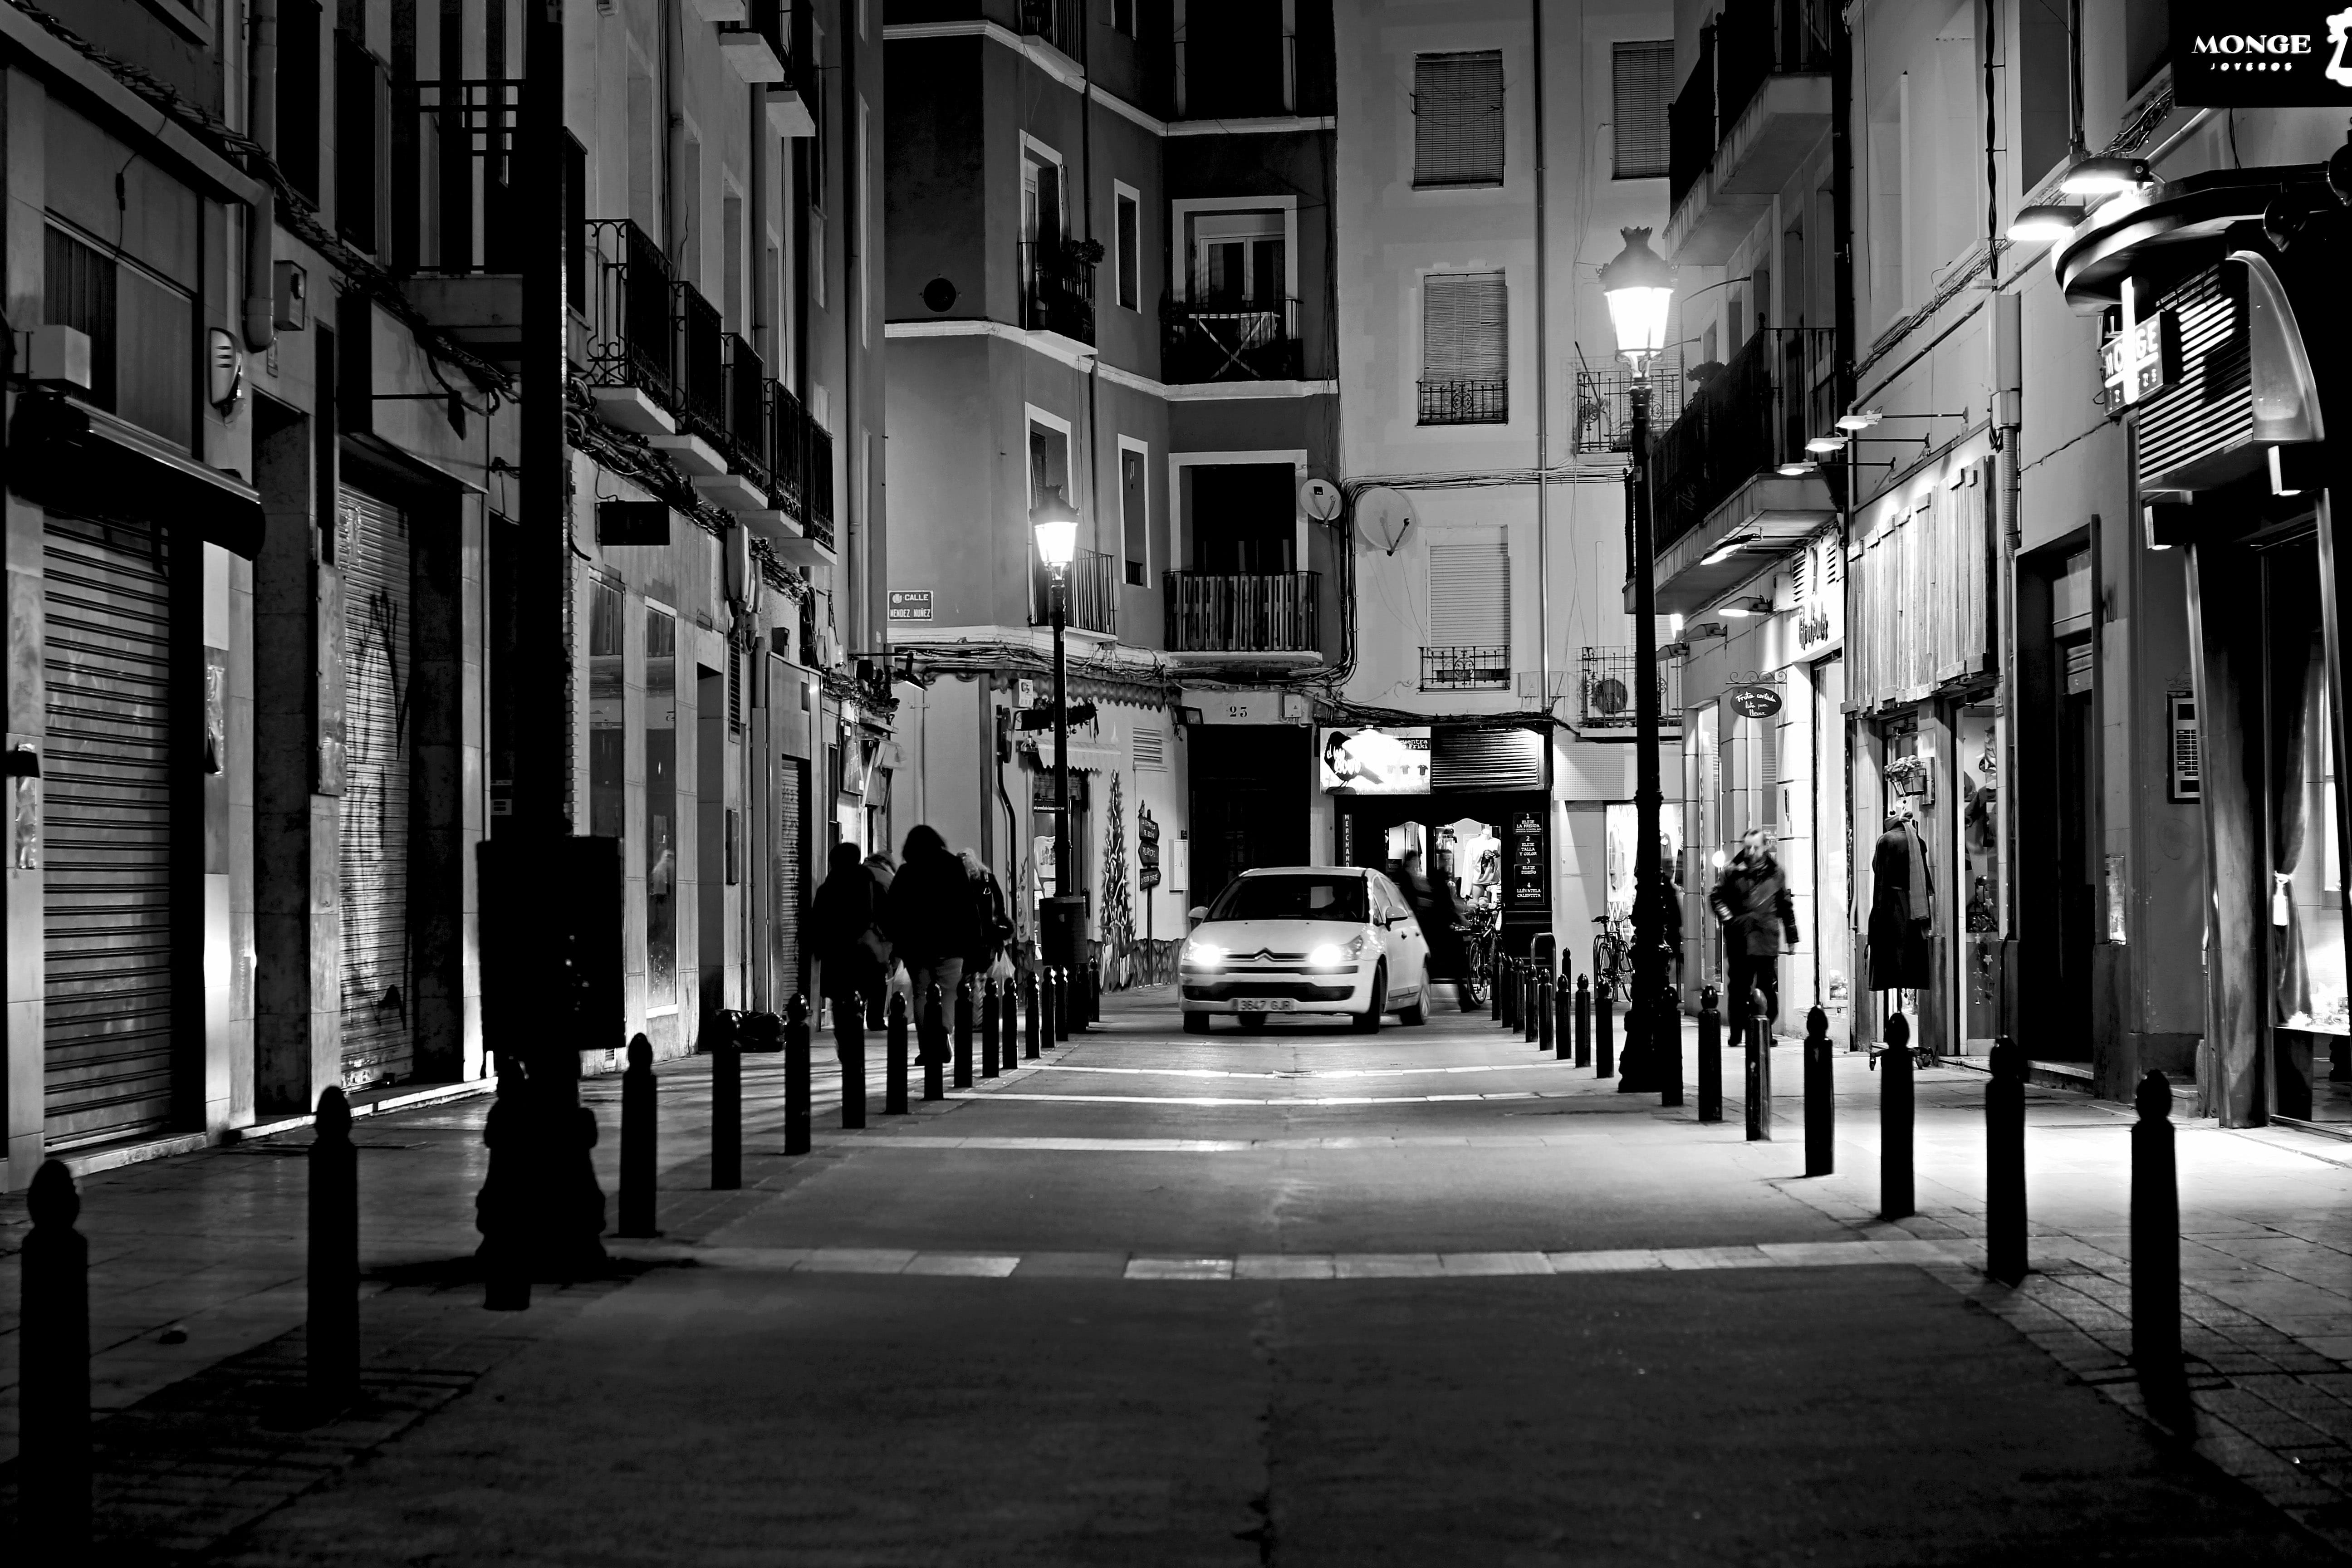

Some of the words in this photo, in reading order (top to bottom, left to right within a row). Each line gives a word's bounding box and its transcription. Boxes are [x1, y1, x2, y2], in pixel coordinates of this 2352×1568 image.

[2191, 35, 2311, 54] MONGE
[2210, 63, 2292, 71] JOYEROS
[2106, 321, 2158, 378] MOGE
[913, 608, 931, 617] NUÑEZ
[1735, 691, 1754, 702] Fruta
[1756, 693, 1776, 702] cortada
[1230, 706, 1247, 717] 23
